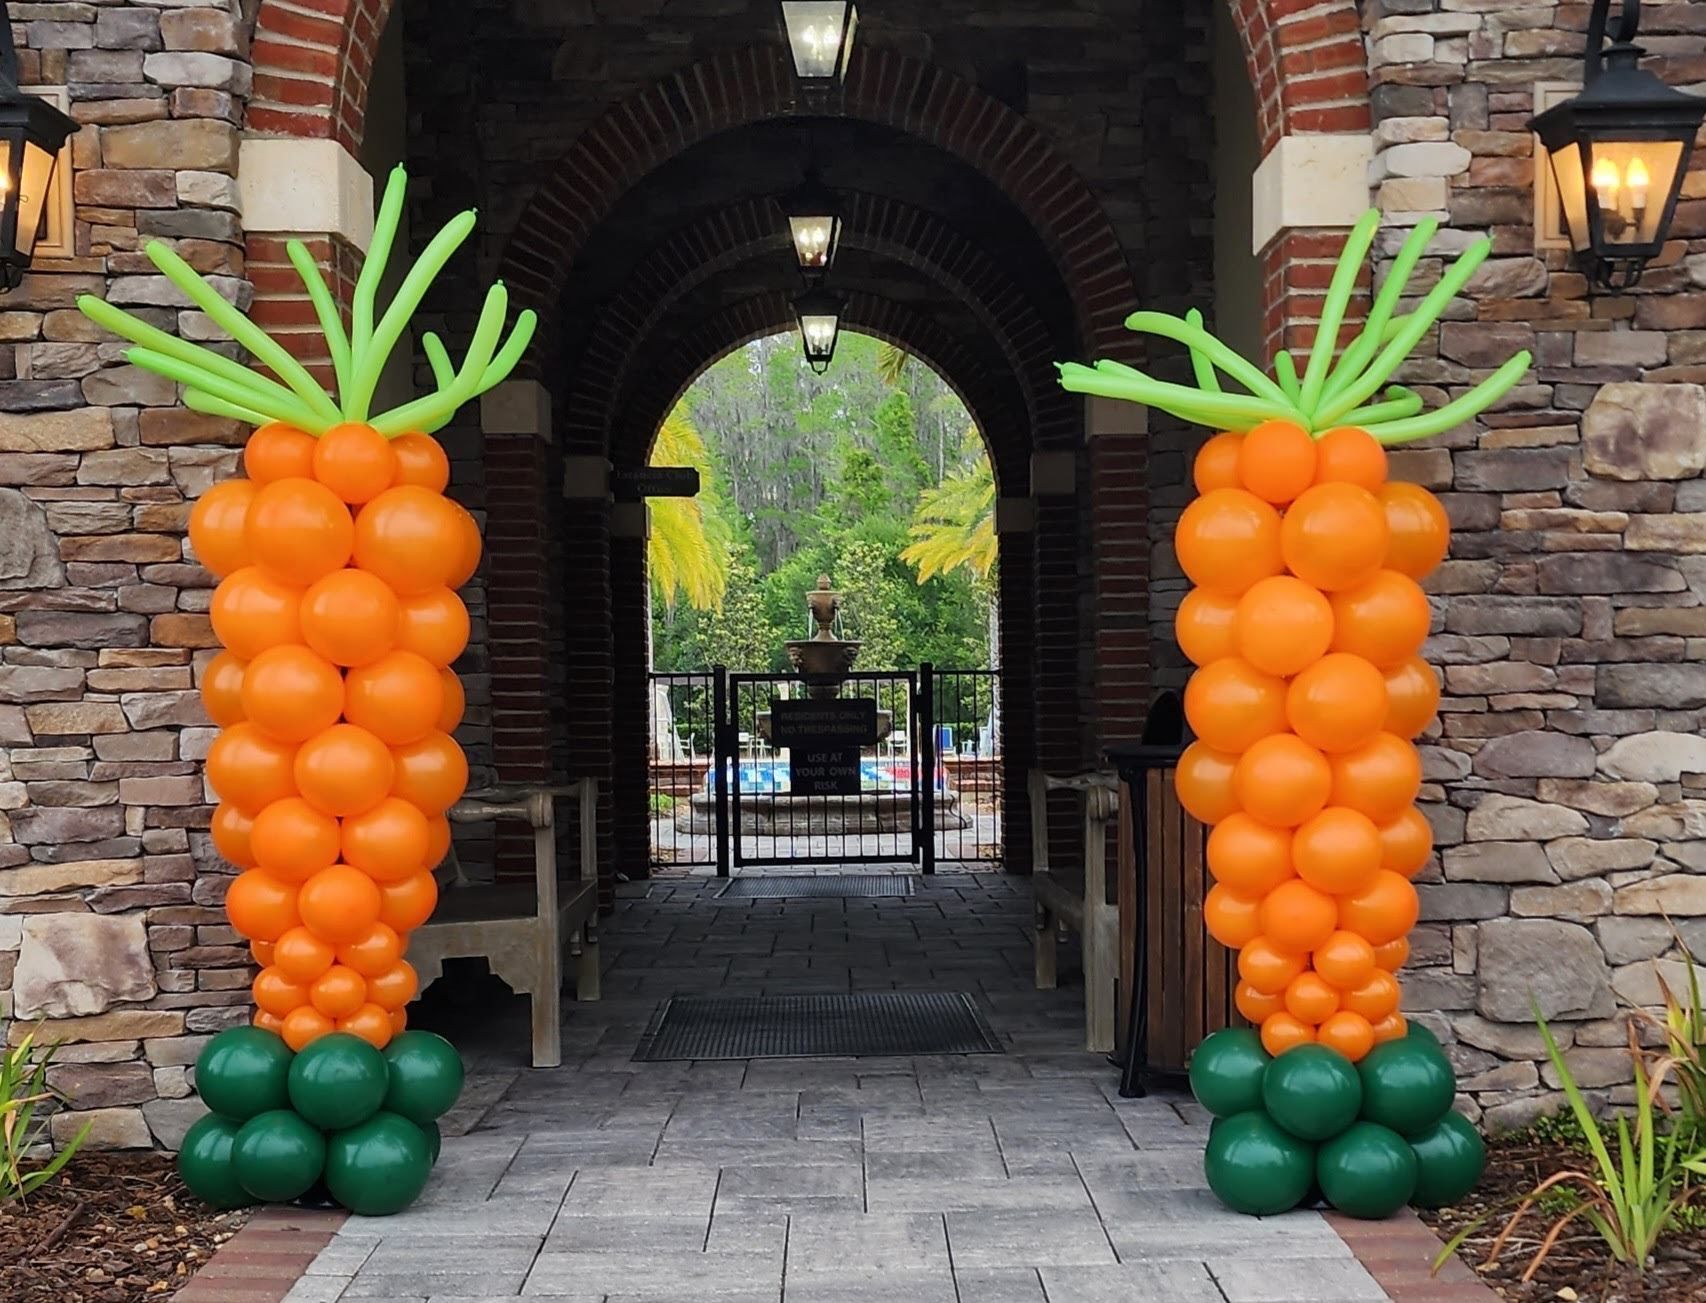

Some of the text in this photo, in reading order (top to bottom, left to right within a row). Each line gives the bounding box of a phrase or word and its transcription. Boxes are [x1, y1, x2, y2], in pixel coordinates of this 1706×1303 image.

[839, 711, 865, 720] ONLY
[807, 753, 843, 763] USE AT
[795, 767, 857, 777] YOUR OWN
[813, 781, 839, 790] RISK
